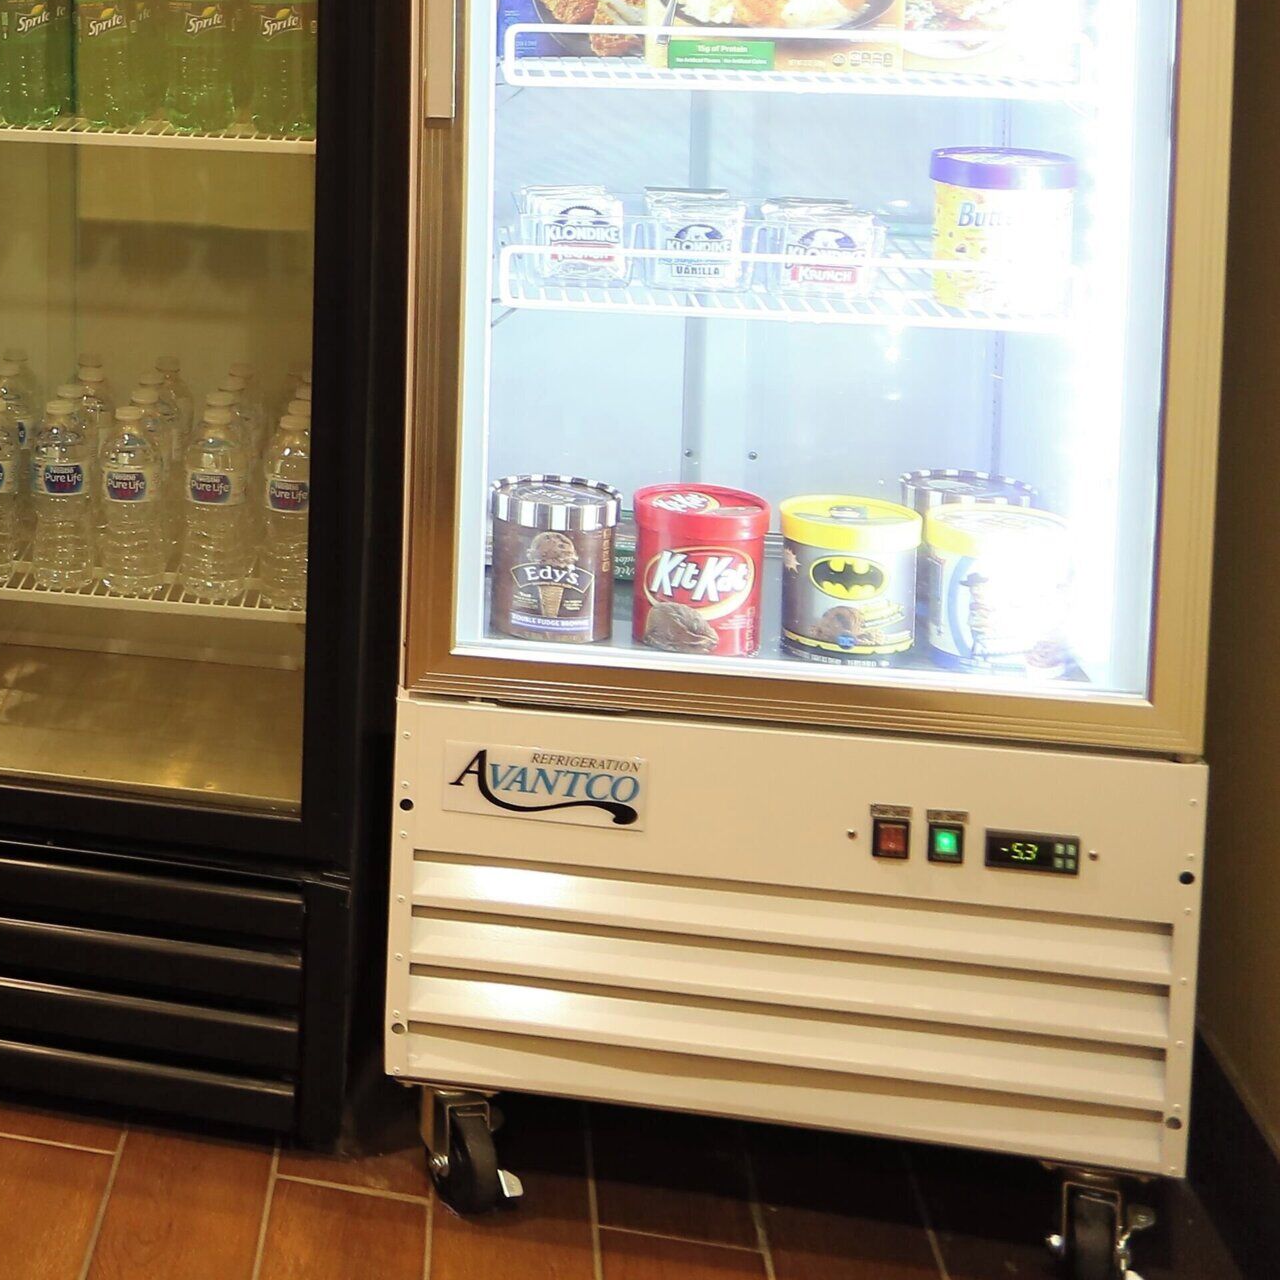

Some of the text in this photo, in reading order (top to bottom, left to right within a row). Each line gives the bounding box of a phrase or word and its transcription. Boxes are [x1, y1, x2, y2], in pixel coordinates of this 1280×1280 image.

[16, 11, 50, 33] Sprite
[88, 14, 123, 36] Sprite
[187, 13, 223, 34] Sprite
[262, 13, 299, 36] Sprite
[545, 224, 620, 243] KLONDIKE
[676, 265, 720, 277] VANILLA
[800, 268, 852, 283] KRUNCH
[45, 472, 83, 486] Pure Life
[107, 480, 145, 493] Pure Life
[191, 481, 230, 496] Pure Life
[270, 489, 308, 503] Pure Life
[524, 565, 579, 587] Edy's
[532, 752, 641, 773] REFRIGERATION
[449, 749, 640, 810] AVANTCO
